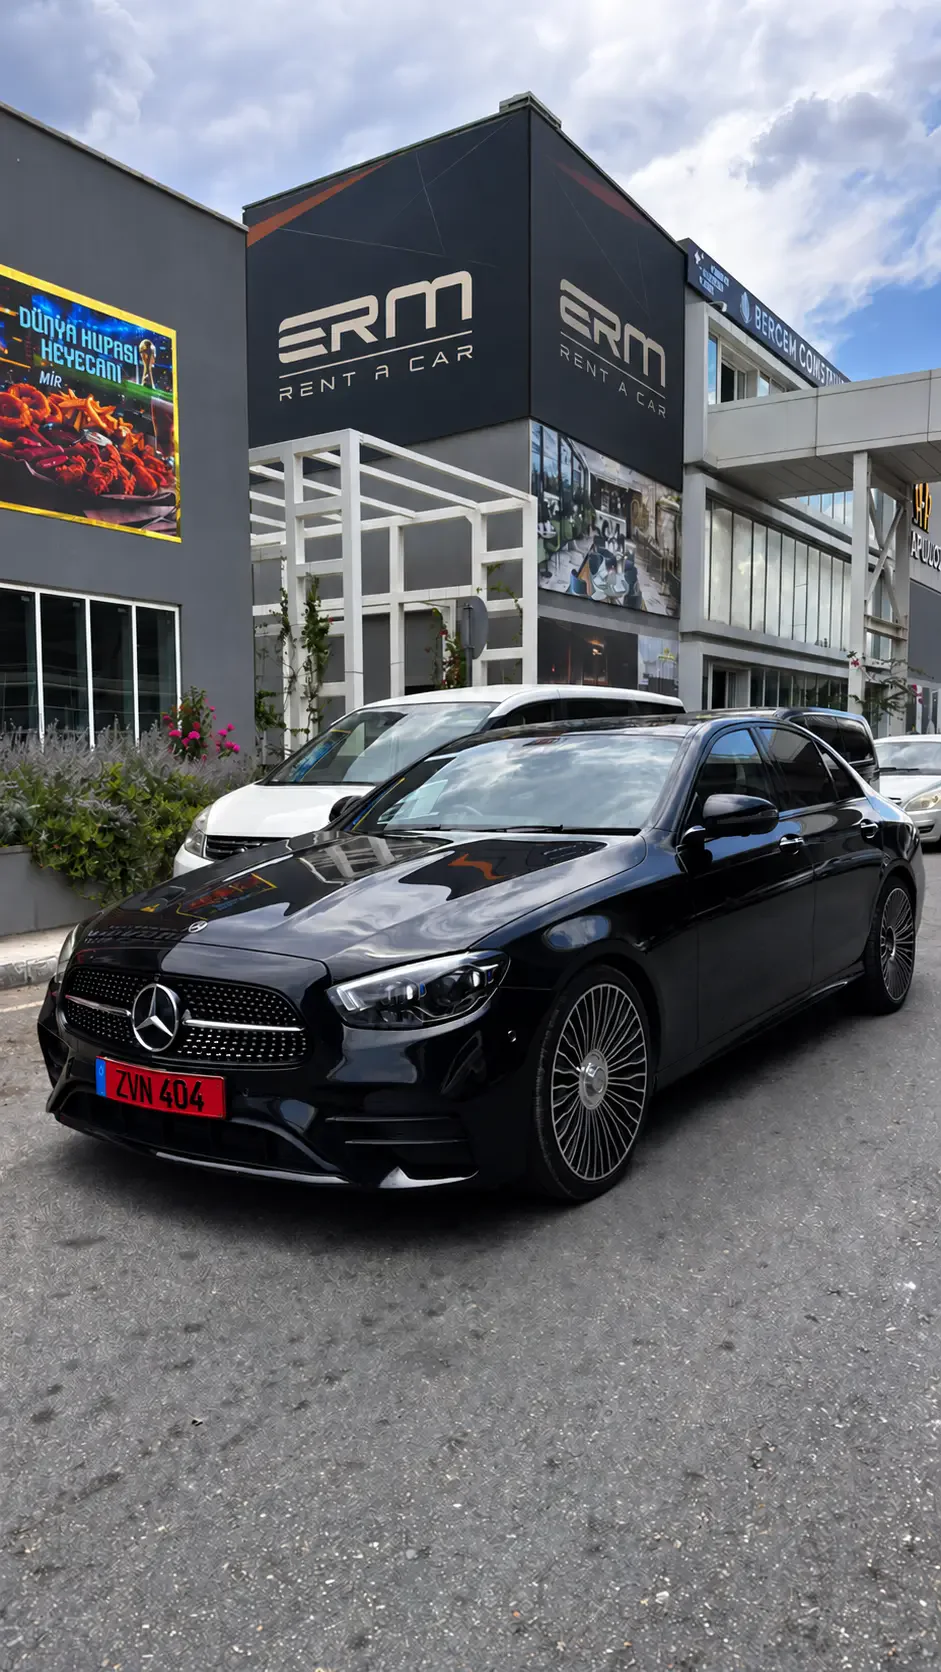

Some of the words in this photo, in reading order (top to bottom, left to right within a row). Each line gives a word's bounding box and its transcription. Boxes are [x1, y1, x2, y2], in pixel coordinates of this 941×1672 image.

[19, 305, 77, 345] DÜNYA
[278, 270, 473, 364] ERM
[559, 278, 666, 388] ERM
[754, 304, 797, 362] BERCEM
[39, 370, 63, 388] MİR
[279, 371, 356, 402] RENT
[375, 364, 389, 380] A
[409, 344, 473, 372] CAR
[560, 343, 608, 383] RENT
[618, 381, 628, 397] A
[636, 391, 666, 419] CAR
[115, 1069, 153, 1105] ZVN
[159, 1078, 205, 1113] 404
